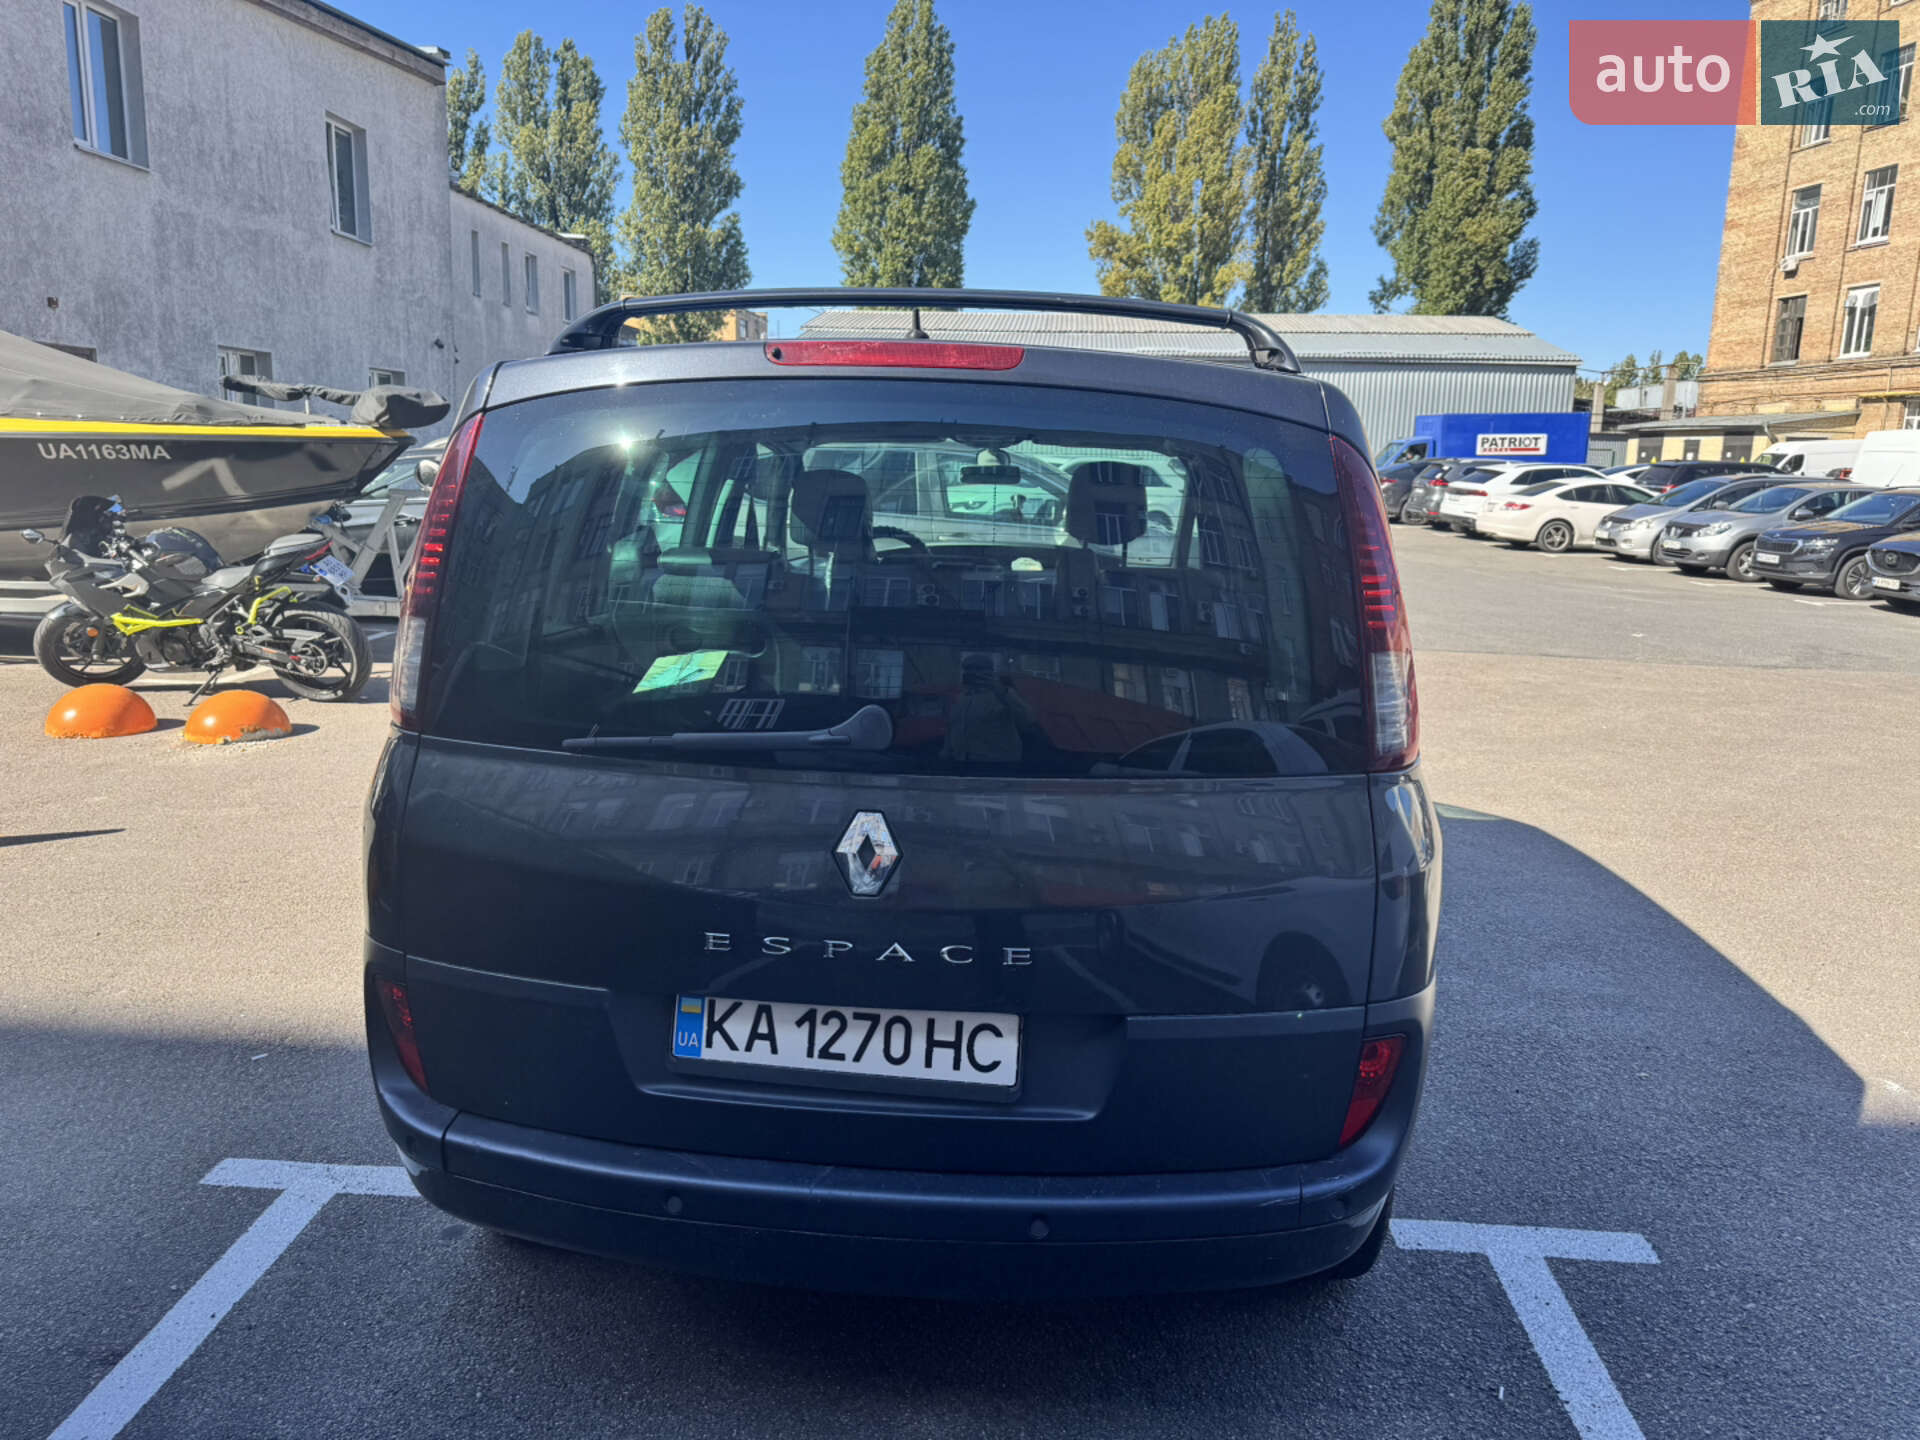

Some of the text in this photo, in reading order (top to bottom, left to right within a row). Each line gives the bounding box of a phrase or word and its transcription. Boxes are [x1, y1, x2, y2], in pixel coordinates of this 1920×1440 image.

[1480, 436, 1542, 448] PATRIOT
[37, 442, 173, 460] UA1163MA
[704, 931, 1033, 966] ESPACE
[678, 1031, 699, 1048] UA
